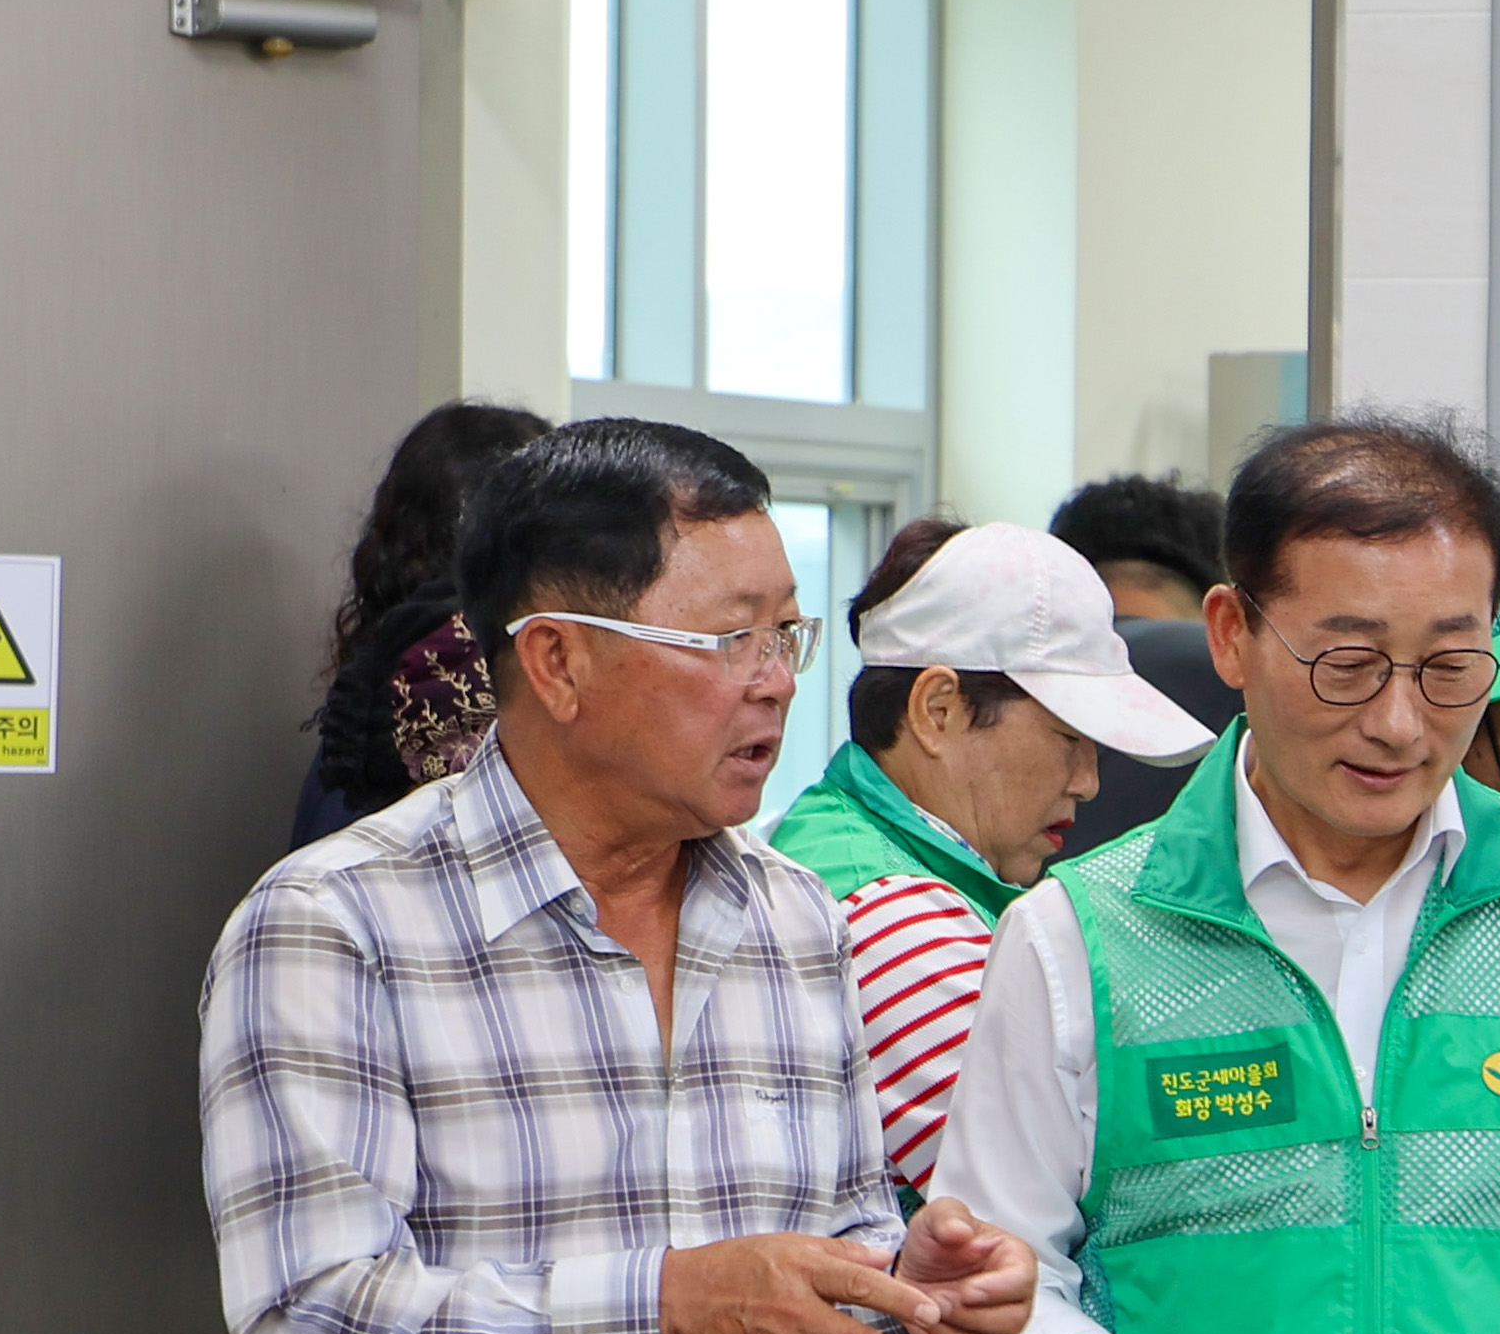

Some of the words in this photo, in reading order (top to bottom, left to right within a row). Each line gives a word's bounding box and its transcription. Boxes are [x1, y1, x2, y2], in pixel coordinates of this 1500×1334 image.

[3, 745, 45, 756] hazard
[1161, 1060, 1279, 1095] 진도군새마을회
[1175, 1096, 1212, 1121] 회장
[1215, 1089, 1273, 1116] 박성수
